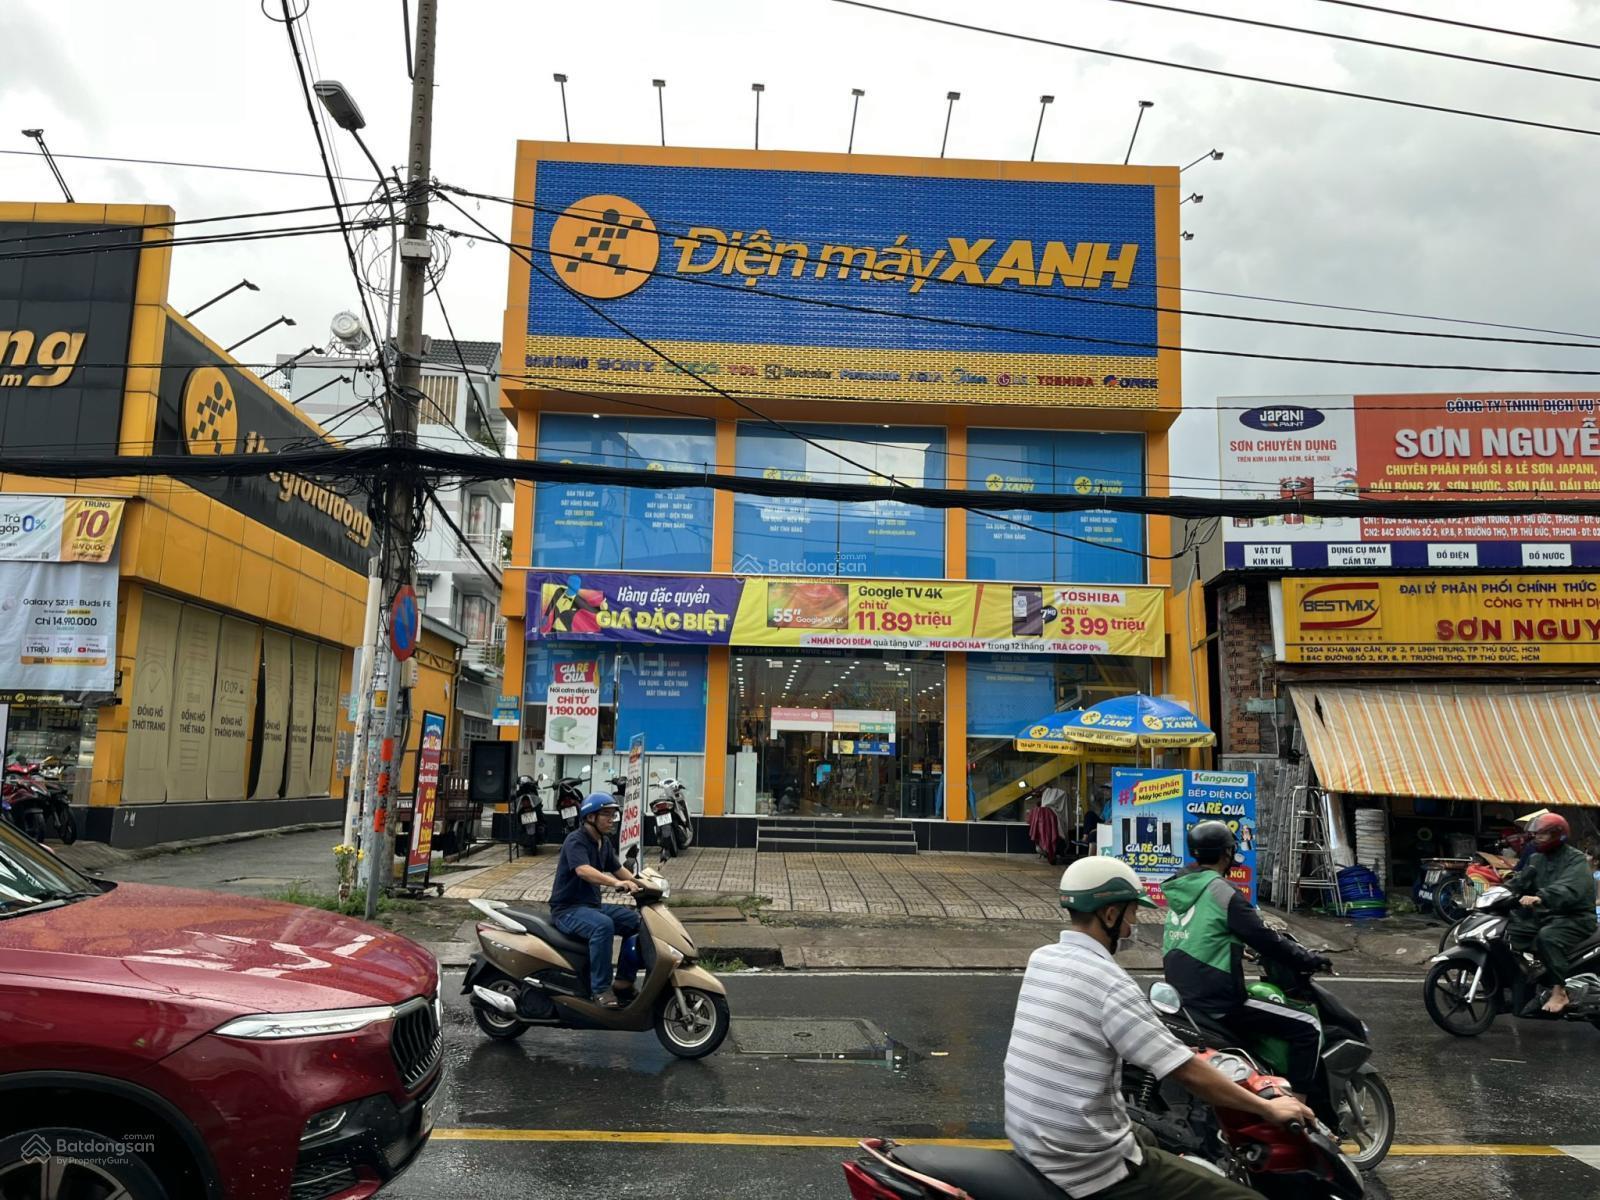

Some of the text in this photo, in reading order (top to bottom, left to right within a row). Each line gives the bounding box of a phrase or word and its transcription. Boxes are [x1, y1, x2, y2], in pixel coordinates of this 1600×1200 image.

[673, 226, 1140, 293] Điện máy XANH
[1446, 398, 1483, 413] CÔNG
[1486, 399, 1501, 413] TY
[1505, 399, 1540, 412] TNHH
[1543, 399, 1575, 415] DỊCH
[1230, 438, 1337, 453] SƠN CHUYÊN DỤNG
[1395, 425, 1470, 459] SƠN
[1386, 461, 1428, 476] CHUYÊN
[1430, 461, 1460, 475] PHÂN
[1463, 459, 1488, 475] PHỐI
[1504, 463, 1513, 475] &
[1531, 462, 1554, 475] SƠN
[1556, 463, 1598, 476] JAPANI,
[1507, 480, 1530, 491] SƠN
[76, 510, 110, 538] 10
[1363, 528, 1380, 537] CN2:
[1464, 525, 1492, 537] TRƯỜNG
[1553, 528, 1577, 537] TP.HCM
[1331, 546, 1354, 556] DỤNG
[1449, 551, 1470, 560] ĐIỆN
[1253, 558, 1269, 566] KIM
[1362, 557, 1377, 565] TAY
[858, 586, 943, 600] Google TV 4K
[1399, 579, 1597, 596] ĐẠI LÝ PHÂN PHỐI CHÍNH THỨC
[617, 584, 711, 608] Hàng đặc quyền
[1060, 591, 1120, 603] TOSHIBA
[23, 598, 54, 608] Galaxy
[858, 600, 889, 610] chỉ từ
[1303, 600, 1376, 612] BESTMIX
[1484, 597, 1583, 608] CÔNG TY TNHH
[1060, 606, 1089, 616] chỉ từ
[595, 606, 731, 636] GIÁ ĐẶC BIỆT
[854, 611, 952, 633] 11.89 triệu
[1060, 616, 1146, 636] 3.99 triệu
[1436, 617, 1600, 641] SƠN NGUY
[909, 640, 922, 648] VIP
[988, 643, 1010, 651] trong
[1020, 642, 1045, 652] tháng
[548, 706, 598, 716] 1.190.000
[1099, 718, 1132, 728] XANH
[1166, 720, 1198, 728] XANH
[1194, 773, 1246, 785] Kangaroo
[1138, 792, 1152, 801] Máy
[1152, 790, 1161, 800] lọc
[1126, 853, 1158, 866] 3.99
